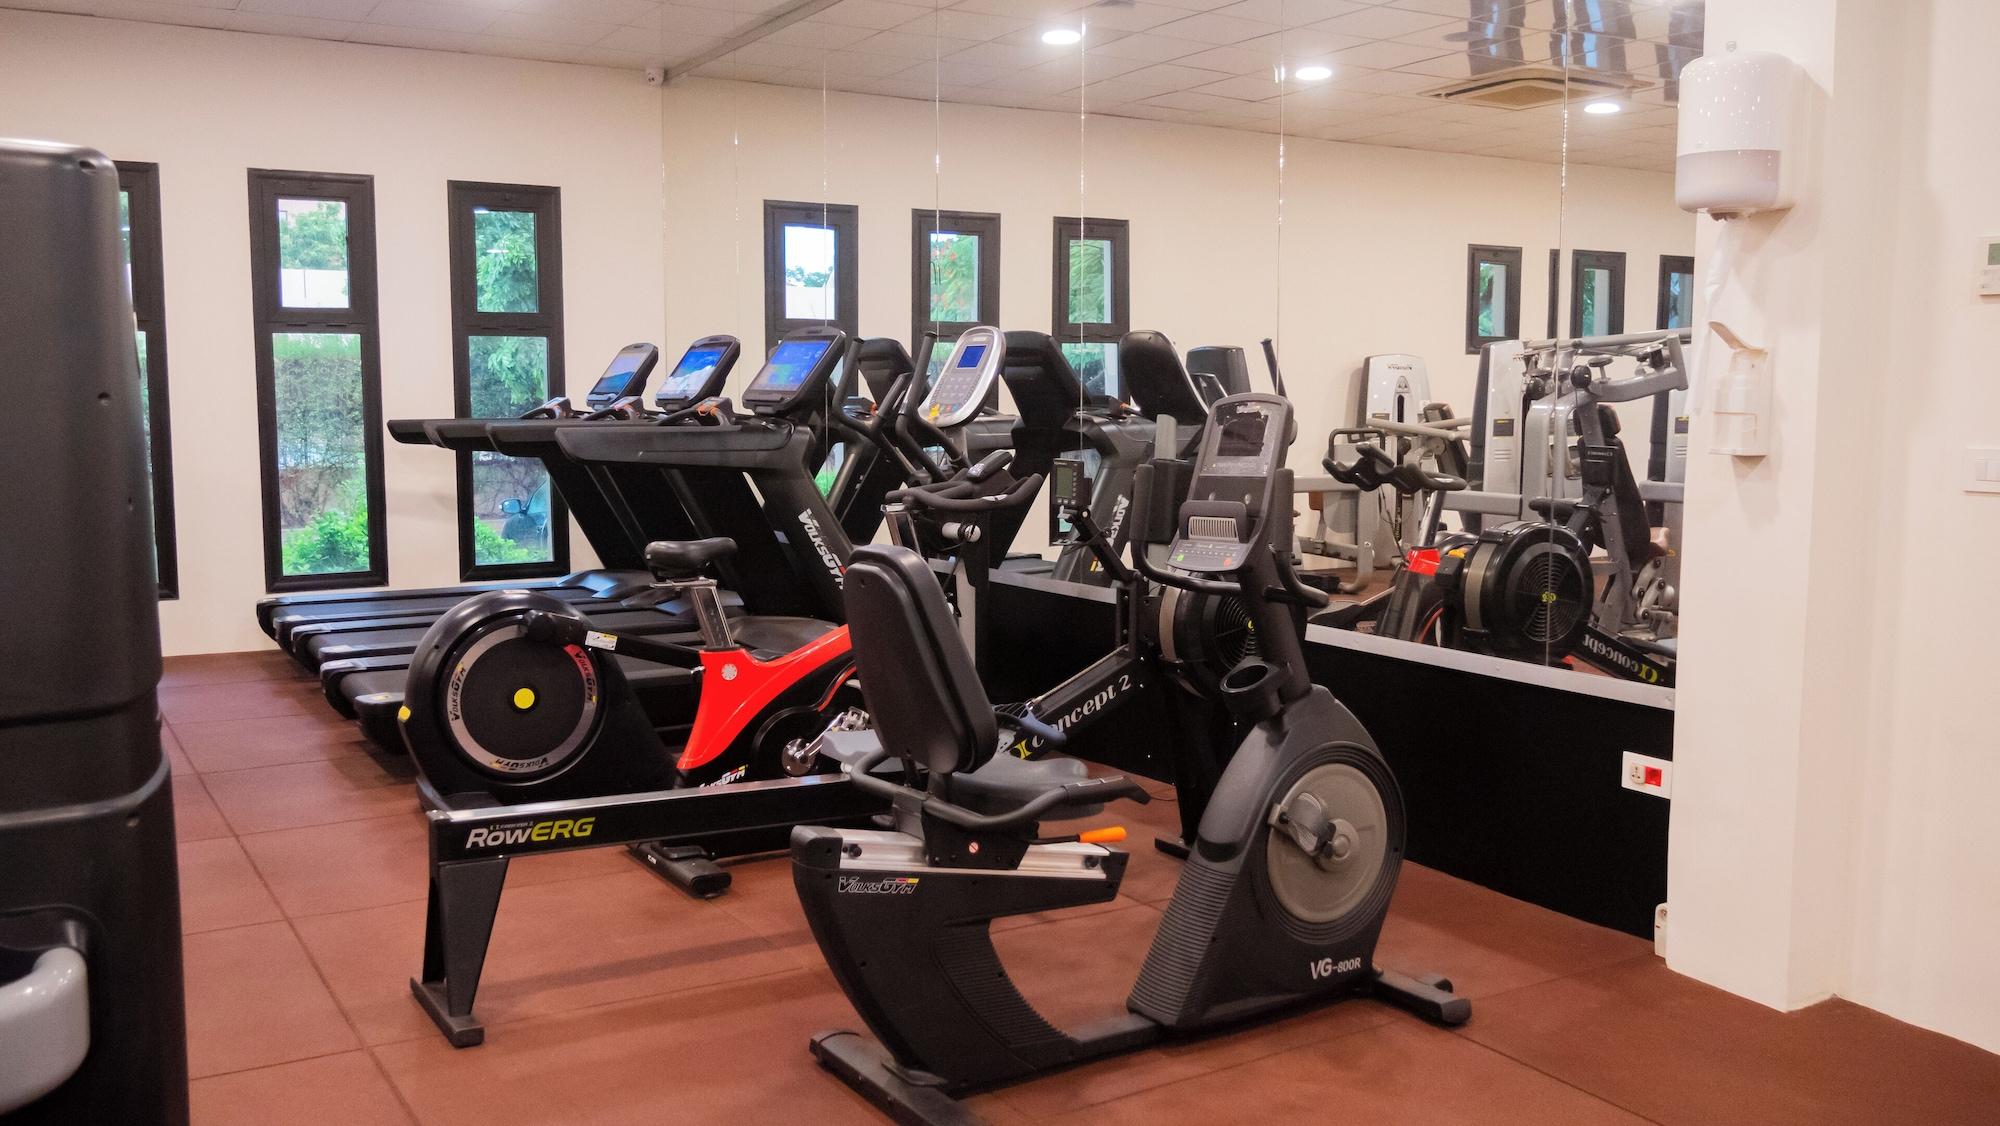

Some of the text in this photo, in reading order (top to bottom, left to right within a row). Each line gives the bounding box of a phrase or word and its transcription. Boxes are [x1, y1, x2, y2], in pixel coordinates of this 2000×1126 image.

[1031, 674, 1132, 748] cncept 2
[1310, 957, 1362, 980] VG-800R
